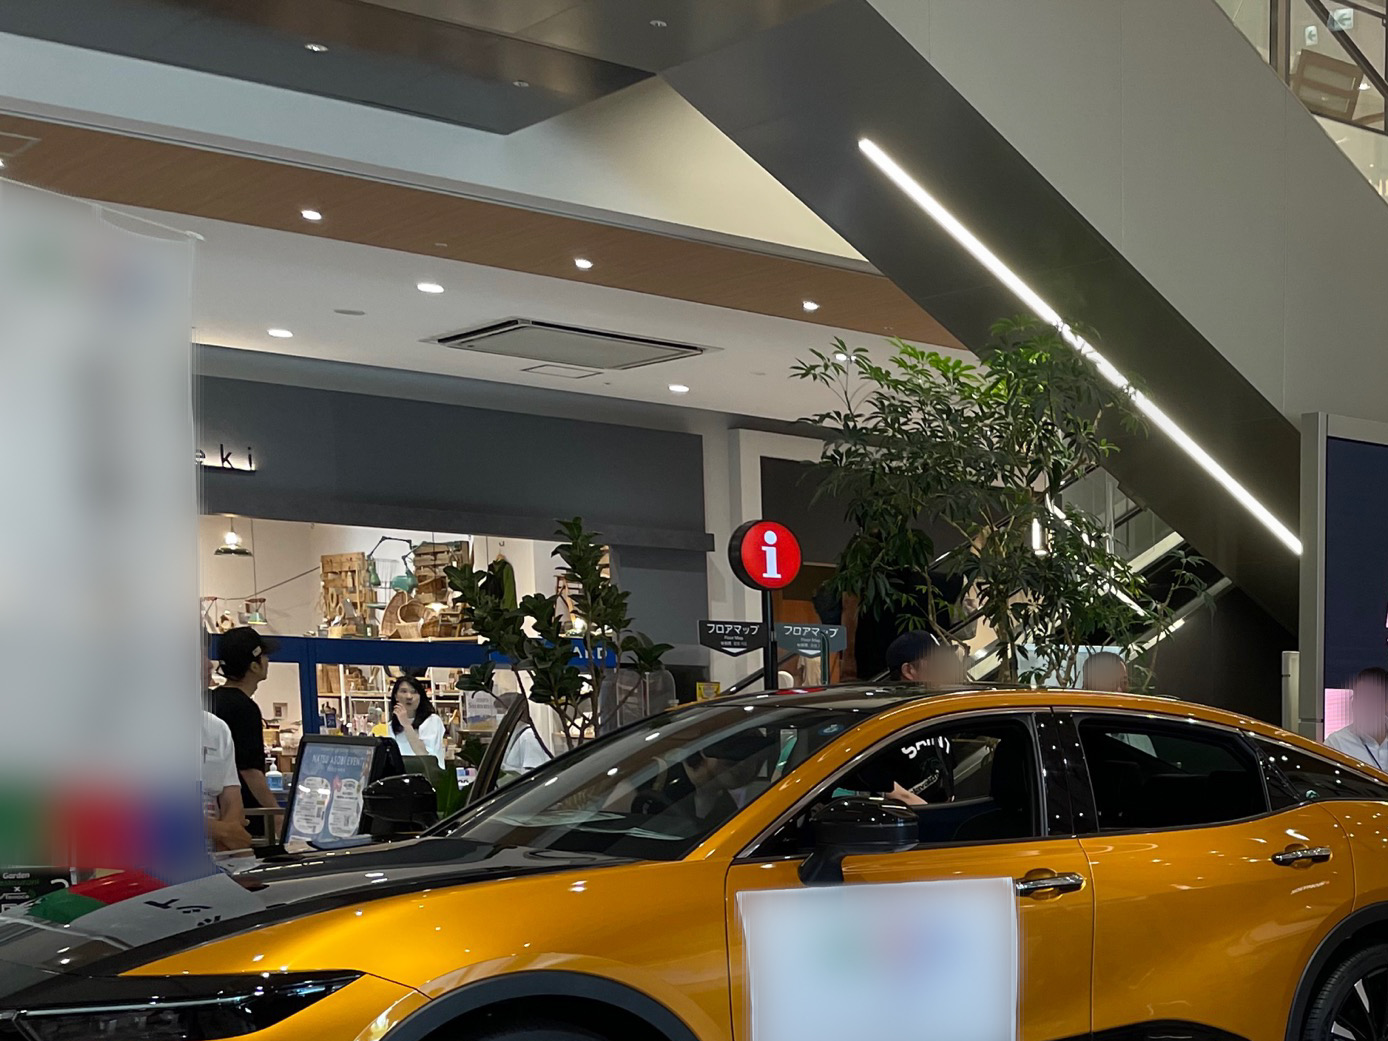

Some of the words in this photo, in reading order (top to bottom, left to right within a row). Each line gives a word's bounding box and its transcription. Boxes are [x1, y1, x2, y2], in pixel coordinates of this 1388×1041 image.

[707, 623, 760, 635] フロアマップ
